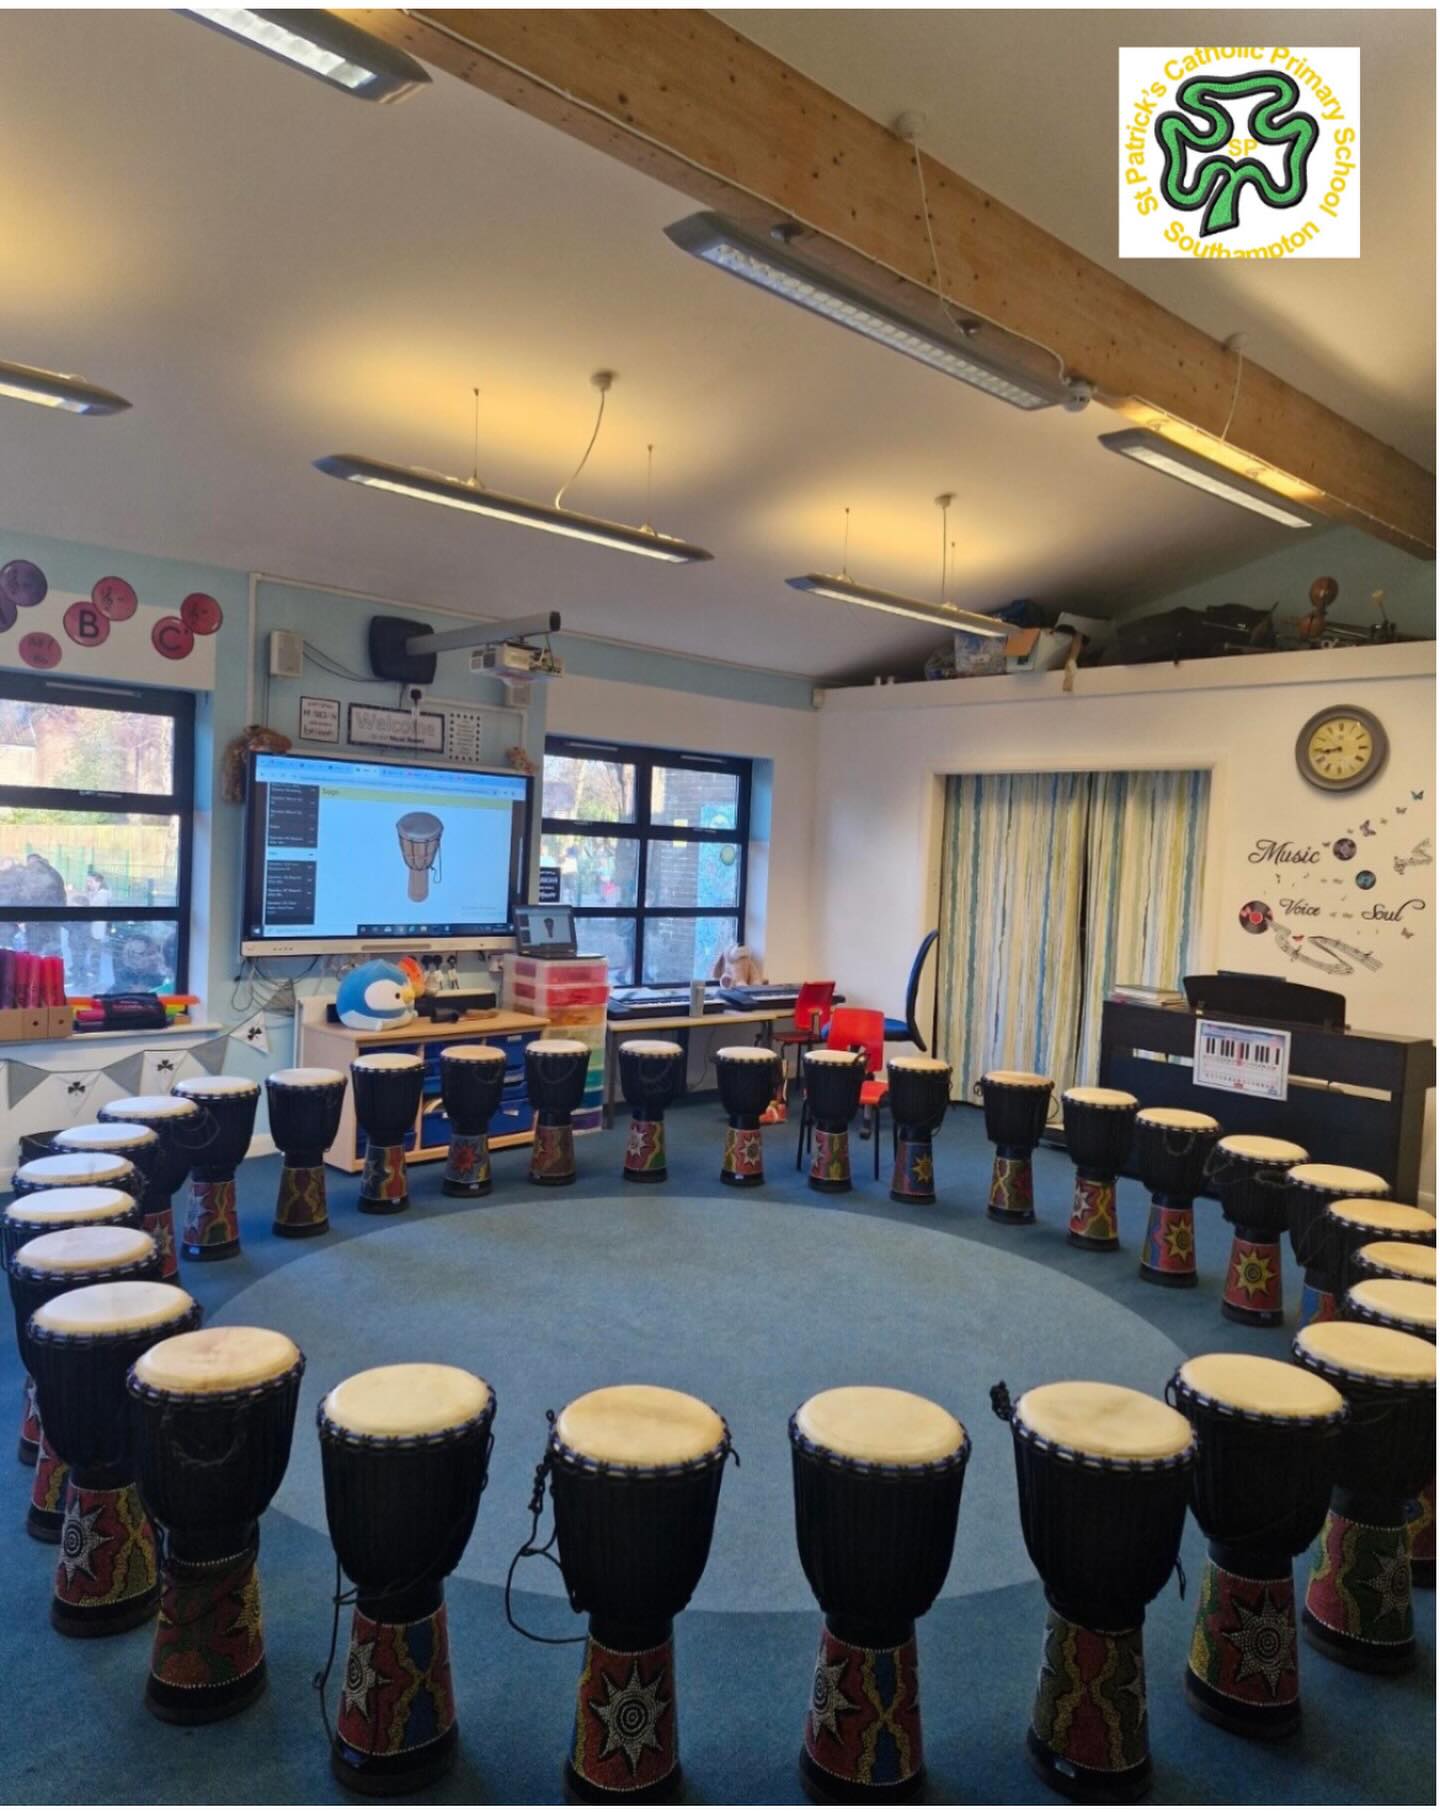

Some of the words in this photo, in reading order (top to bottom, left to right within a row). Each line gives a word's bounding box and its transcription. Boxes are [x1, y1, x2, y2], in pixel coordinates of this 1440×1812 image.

[79, 609, 99, 639] B
[1248, 839, 1321, 866] Music
[1279, 898, 1321, 917] Voice
[1360, 898, 1426, 923] Soul
